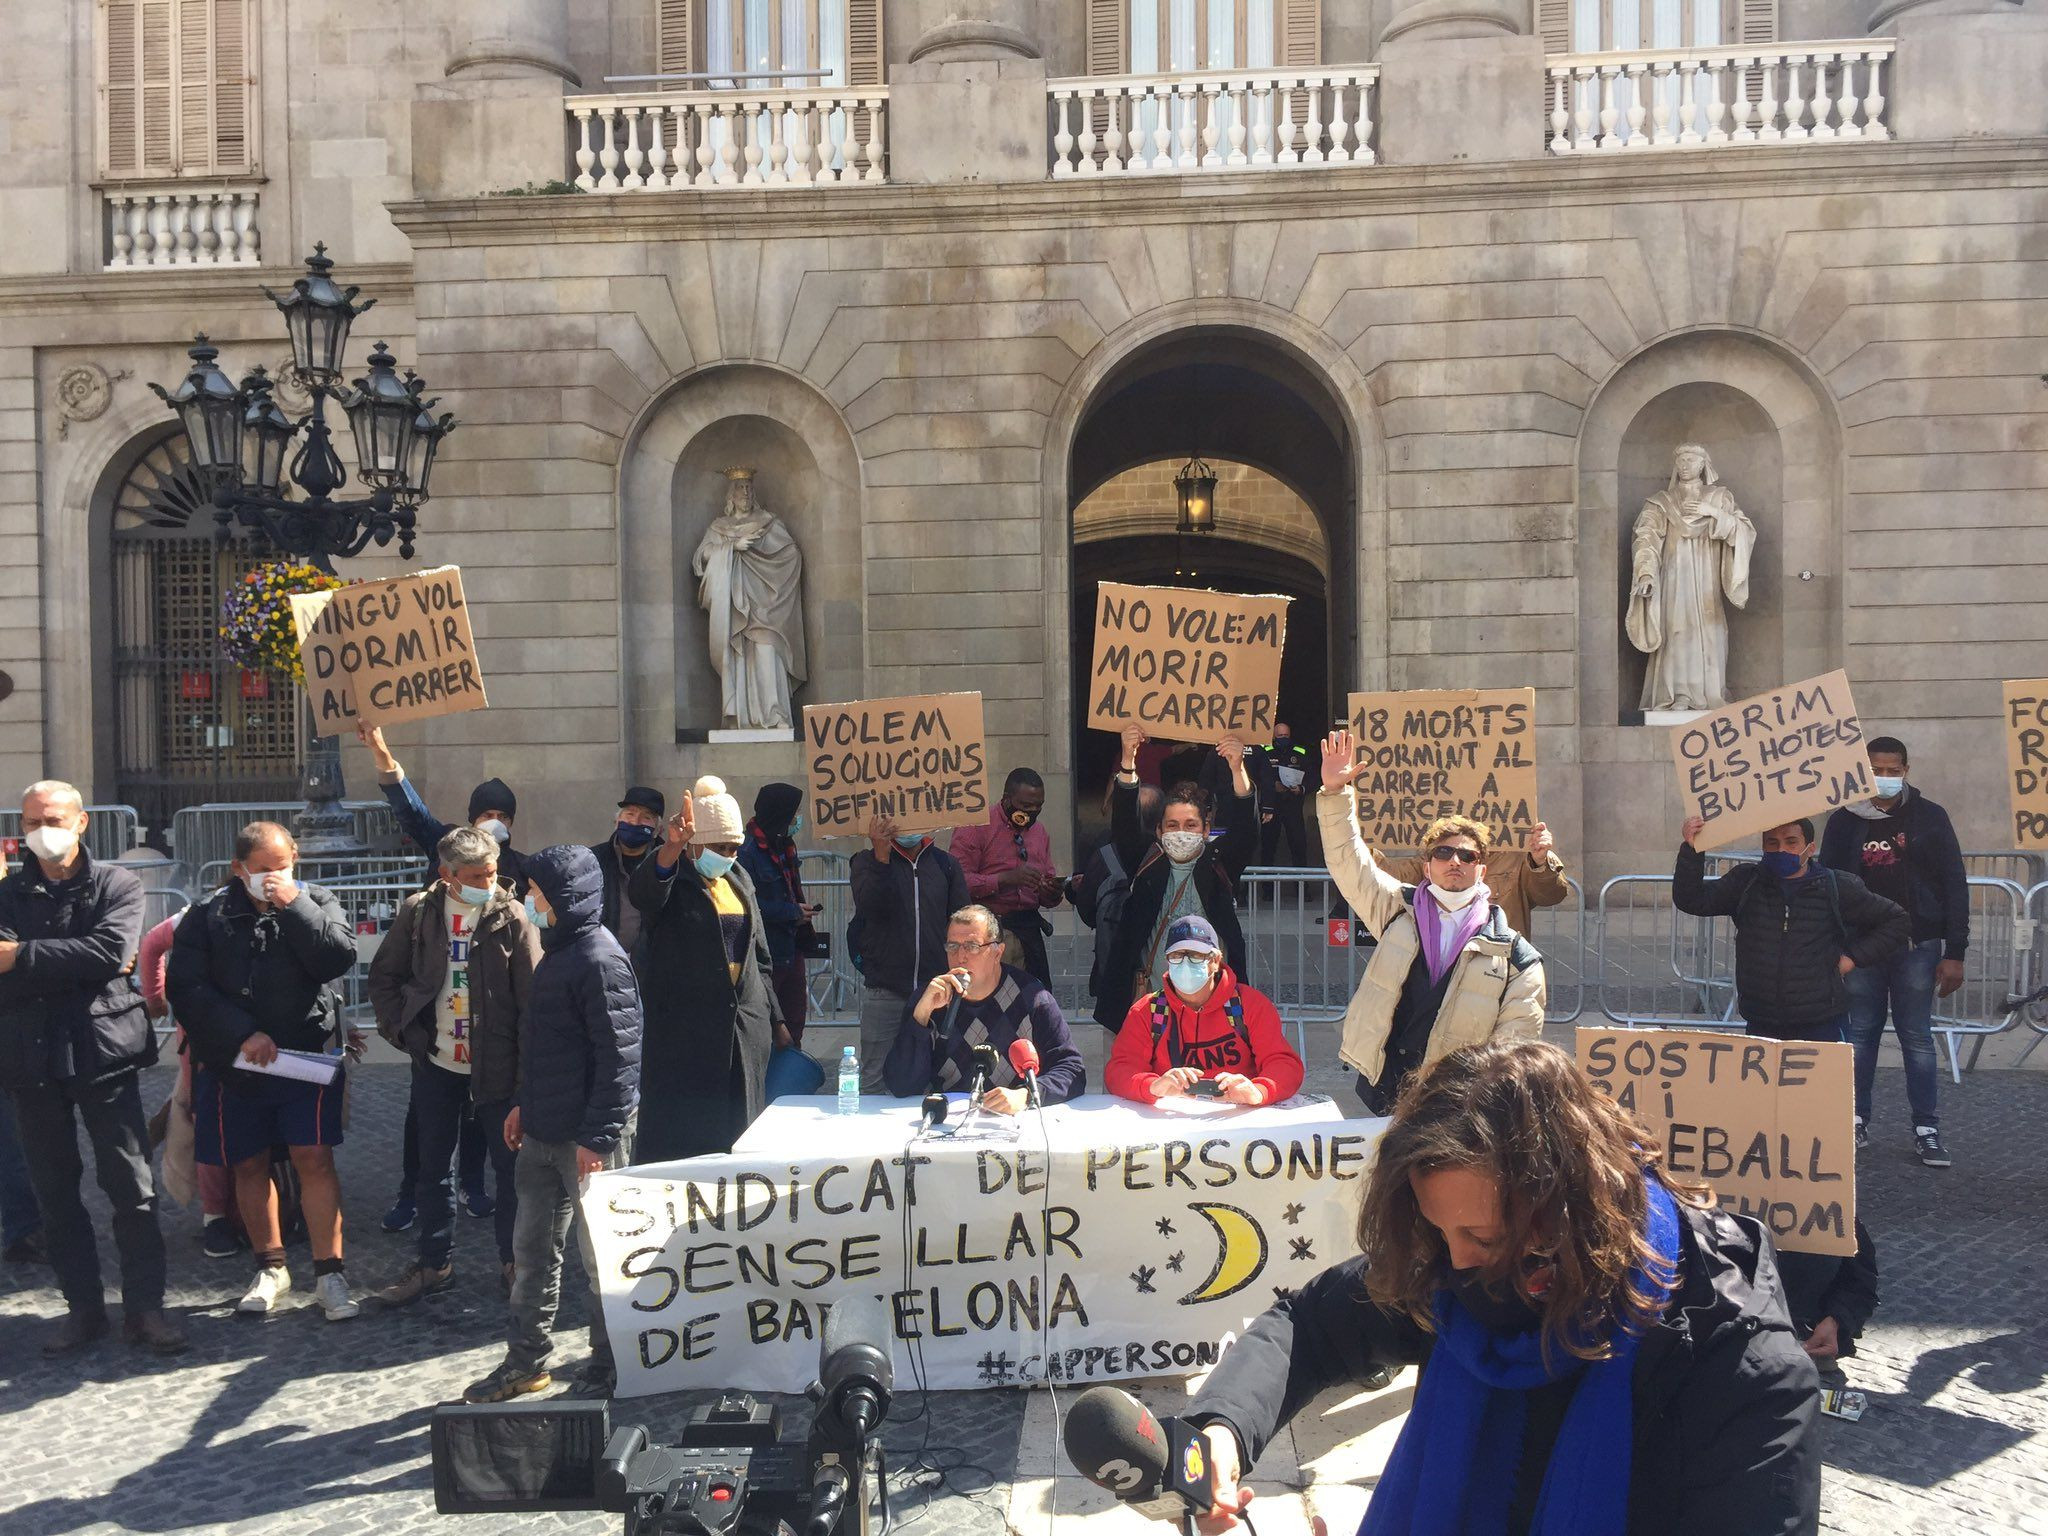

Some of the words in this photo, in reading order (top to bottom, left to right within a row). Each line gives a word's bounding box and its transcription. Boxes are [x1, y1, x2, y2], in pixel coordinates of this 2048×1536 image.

[412, 580, 463, 616] VOL
[1102, 595, 1151, 633] NO
[1167, 604, 1277, 648] VOLEM
[322, 688, 357, 721] AL
[369, 658, 482, 710] CARRER
[1096, 683, 1131, 718] AL
[1138, 691, 1271, 732] CARRER
[810, 707, 951, 749] VOLEM
[1353, 706, 1389, 743] 18
[1401, 703, 1528, 740] MORTS
[1492, 741, 1533, 769] AL
[1689, 749, 1751, 794] ELS
[1758, 715, 1862, 767] HOTELS
[1354, 769, 1453, 797] CARRER
[1480, 772, 1499, 799] A
[1825, 761, 1871, 806] JA!
[2015, 765, 2048, 795] D'
[1357, 797, 1532, 826] BARCELONA
[1585, 1036, 1820, 1087] SOSTRE
[976, 1148, 1046, 1196] DE
[1085, 1133, 1368, 1193] PERSONE
[1667, 1123, 1843, 1183] EBALL
[620, 1233, 882, 1313] SENSE
[916, 1206, 1084, 1269] LLAR
[637, 1311, 721, 1370] DE
[747, 1272, 1090, 1345] BAELONA
[976, 1339, 1234, 1386] #CAPPERSON
